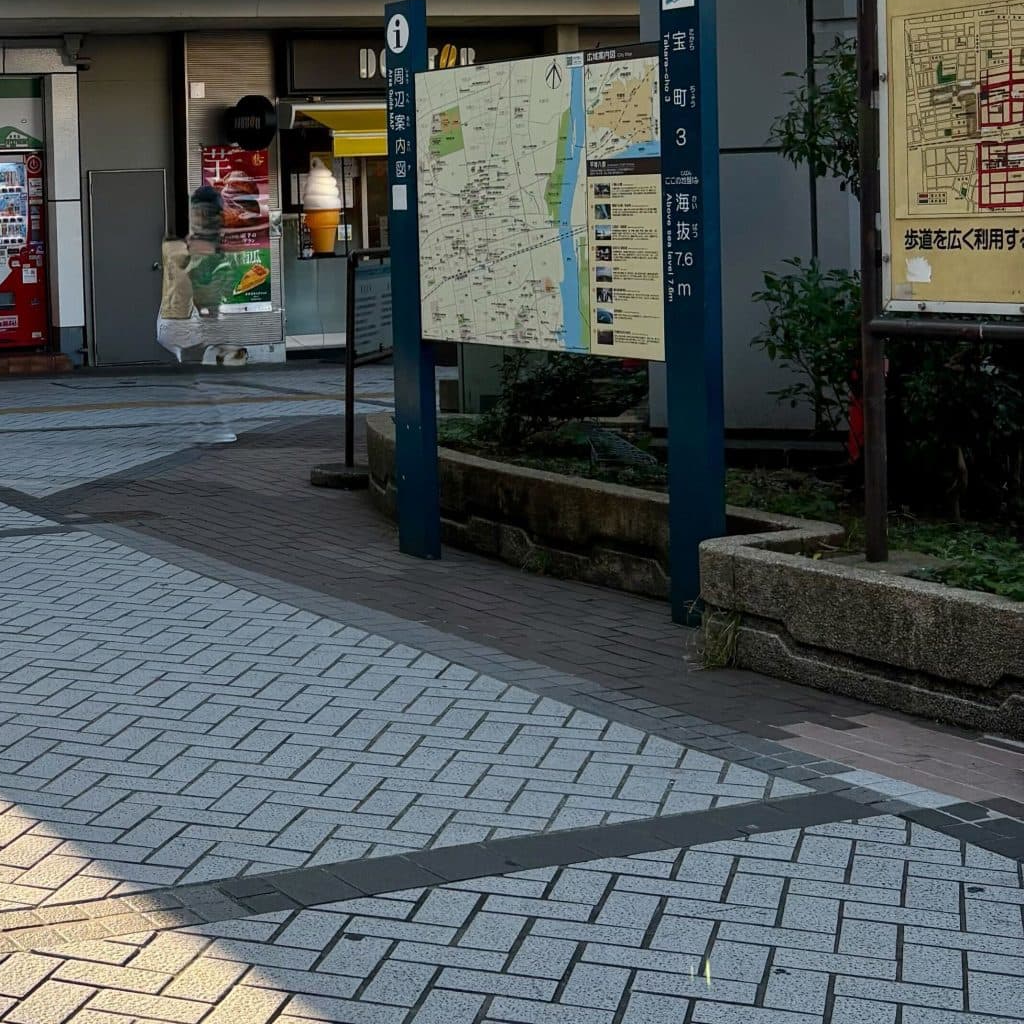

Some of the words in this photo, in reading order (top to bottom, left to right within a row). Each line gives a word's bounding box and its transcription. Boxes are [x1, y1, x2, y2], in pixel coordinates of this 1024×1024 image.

[359, 43, 475, 78] DOR
[676, 128, 687, 146] 3
[676, 193, 690, 241] 海抜
[675, 252, 693, 266] 7.6
